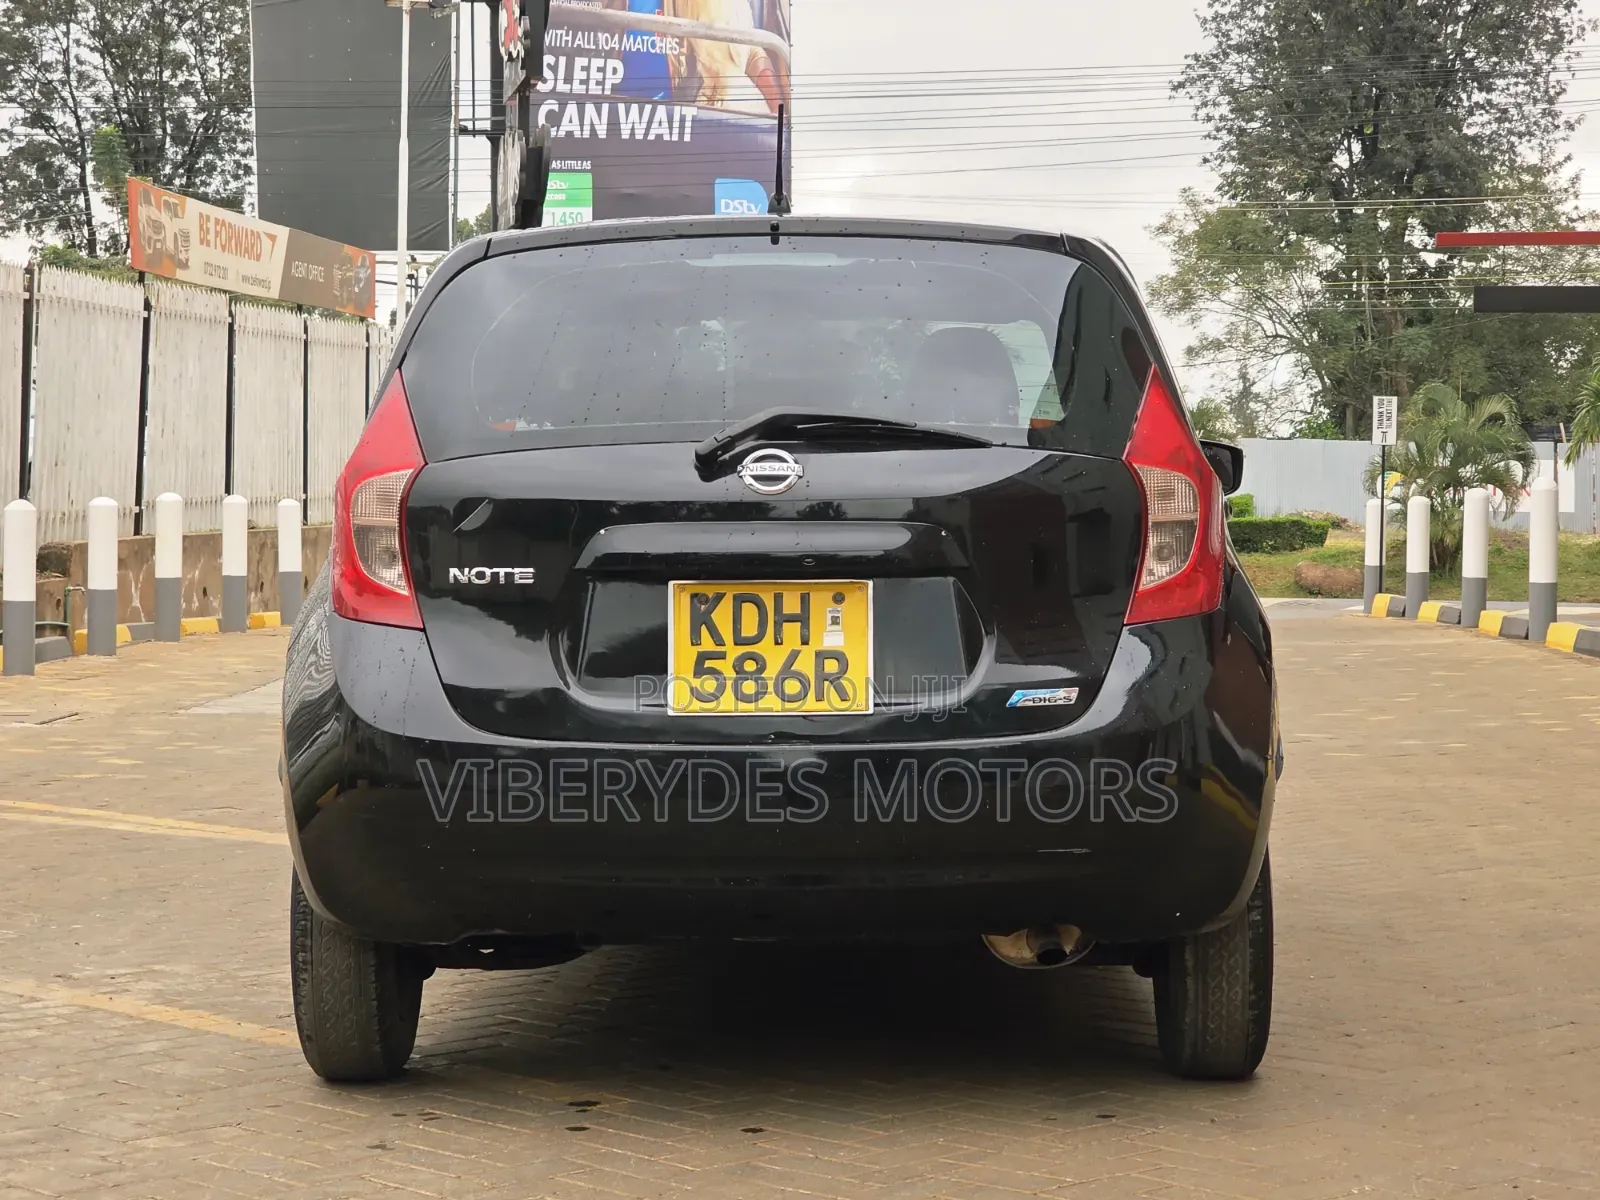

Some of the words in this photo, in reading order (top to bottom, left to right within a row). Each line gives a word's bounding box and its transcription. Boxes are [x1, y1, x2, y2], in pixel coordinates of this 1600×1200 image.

[574, 31, 595, 49] ALL
[597, 31, 619, 51] 104
[621, 33, 680, 54] MATCHES
[536, 54, 625, 95] SLEEP
[537, 99, 610, 139] CAN
[618, 102, 698, 142] WAIT
[551, 160, 561, 170] AS
[561, 160, 582, 170] LITTLE
[582, 160, 592, 170] AS
[720, 198, 762, 215] DStv
[198, 211, 211, 248] BE
[214, 216, 262, 262] FORWARD
[291, 260, 308, 279] AGENT
[308, 263, 325, 283] OFFICE
[1377, 398, 1385, 409] YOU
[1377, 410, 1385, 430] THANK
[1385, 408, 1393, 422] NEXT
[745, 464, 796, 473] NISSAN
[448, 567, 535, 585] NOTE
[689, 591, 811, 647] KDH
[689, 648, 851, 704] 586R
[1031, 695, 1074, 704] DIG-S
